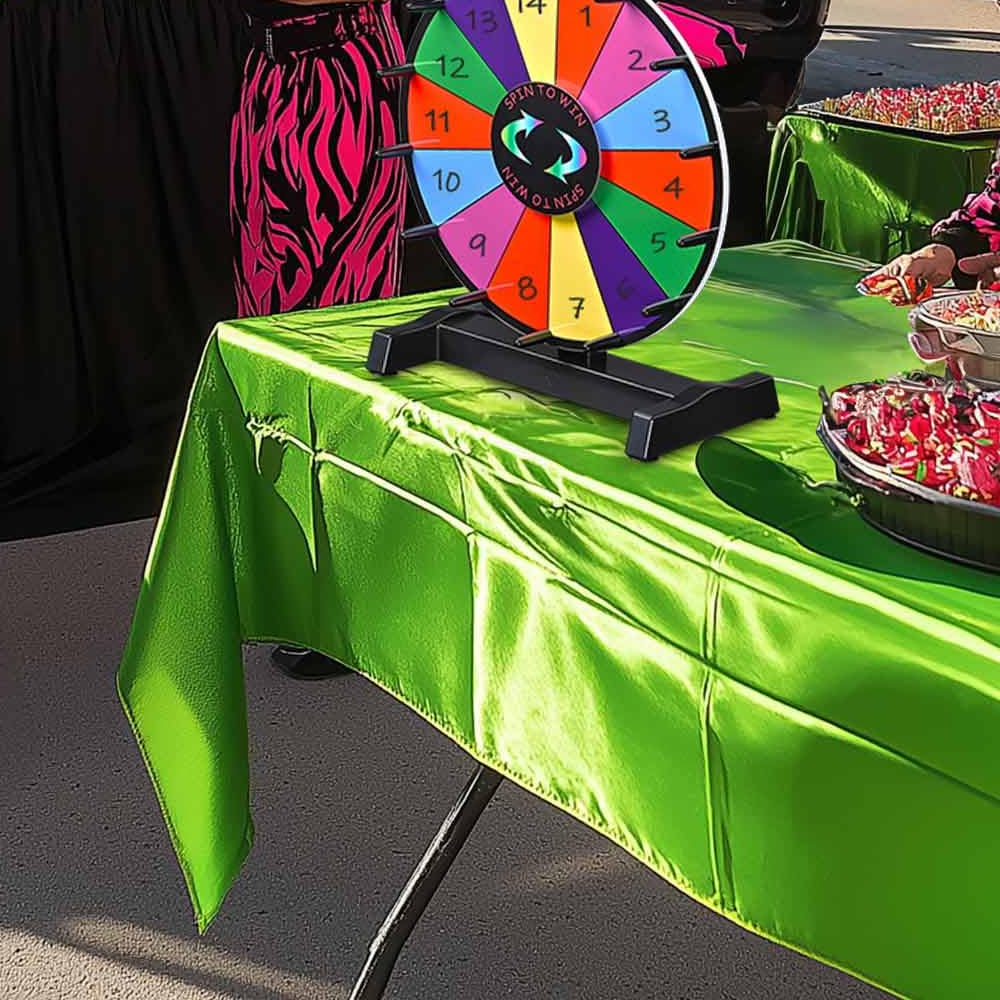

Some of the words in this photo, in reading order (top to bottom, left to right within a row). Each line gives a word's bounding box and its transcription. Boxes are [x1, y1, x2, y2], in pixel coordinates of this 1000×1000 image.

[468, 9, 498, 34] 13
[578, 5, 592, 27] 1
[435, 56, 470, 80] 12
[627, 50, 647, 71] 2
[504, 84, 534, 110] SPIN
[537, 84, 556, 99] TO
[560, 94, 587, 127] WIN
[424, 110, 451, 133] 11
[655, 109, 671, 133] 3
[432, 168, 461, 193] 10
[501, 166, 528, 200] WIN
[663, 176, 684, 200] 4
[531, 194, 552, 209] TO
[554, 183, 585, 209] SPIN
[469, 233, 487, 257] 9
[650, 231, 667, 253] 5
[517, 276, 538, 301] 8
[568, 296, 585, 320] 7
